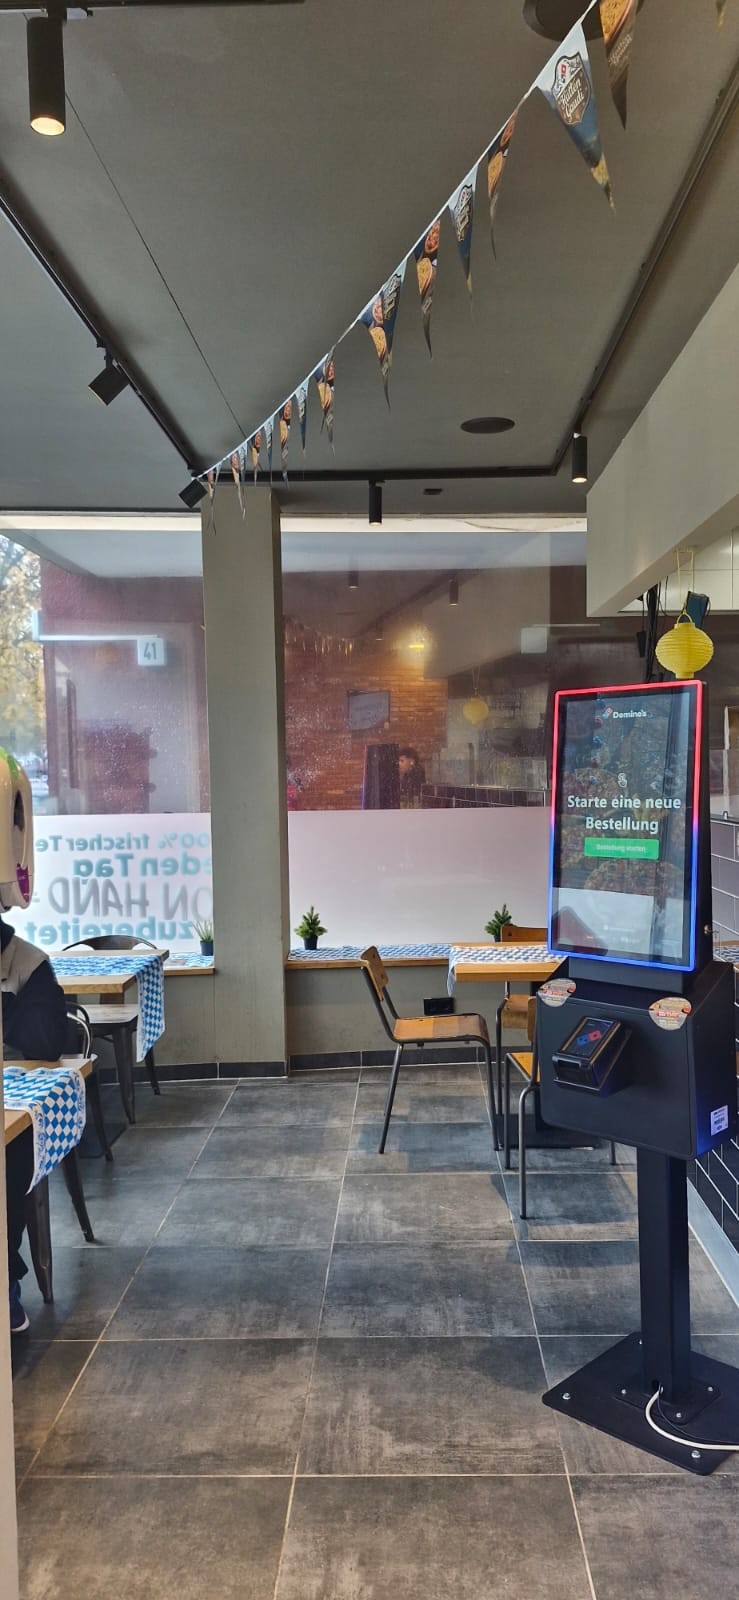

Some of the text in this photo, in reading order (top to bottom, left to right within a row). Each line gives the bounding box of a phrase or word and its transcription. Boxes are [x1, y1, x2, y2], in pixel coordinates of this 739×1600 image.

[143, 641, 158, 661] 41
[612, 709, 647, 719] Domino's
[567, 795, 682, 809] Starte eine neue
[585, 816, 659, 834] Bestellung
